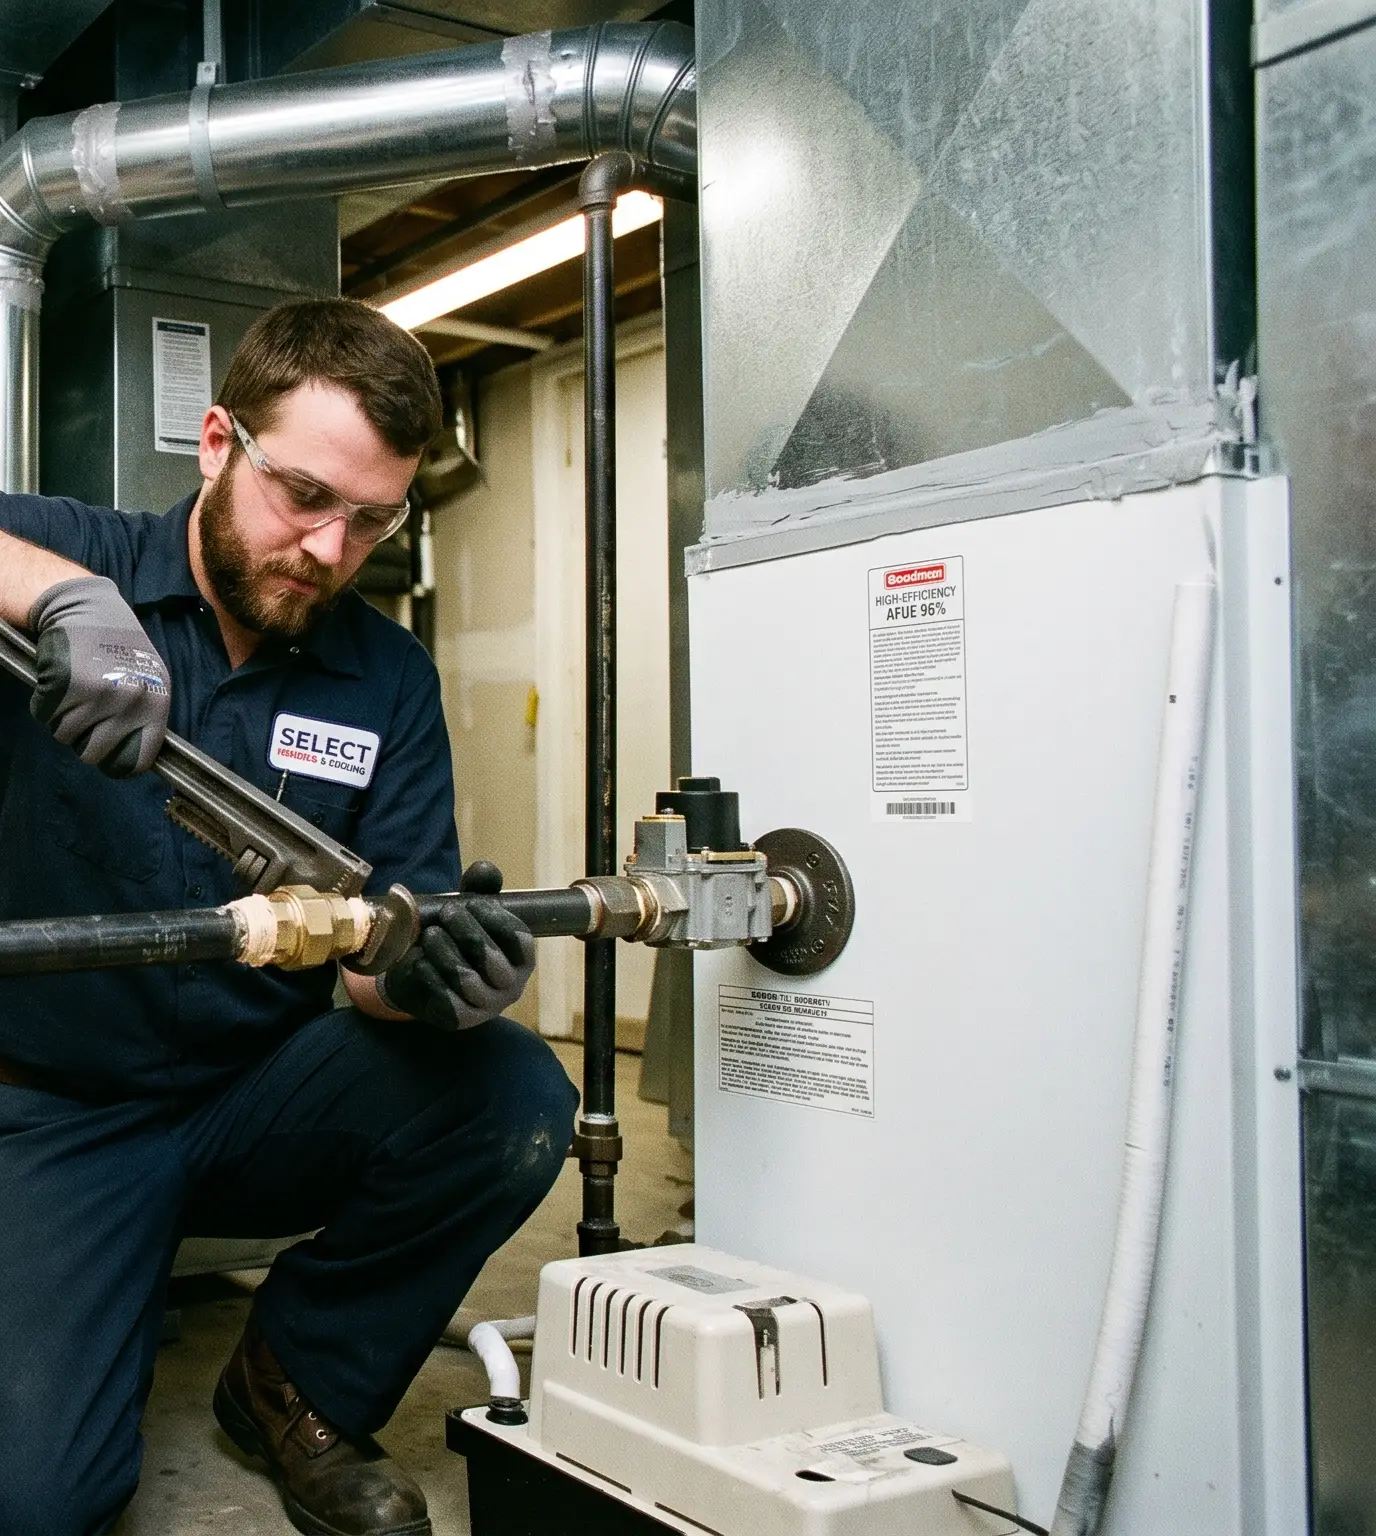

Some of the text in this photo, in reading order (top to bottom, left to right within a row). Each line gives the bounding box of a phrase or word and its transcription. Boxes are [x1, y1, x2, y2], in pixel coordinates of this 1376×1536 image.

[875, 585, 957, 607] HIGH-EFFICIENCY
[886, 601, 947, 621] AFUE 96%
[279, 727, 372, 764] SELECT
